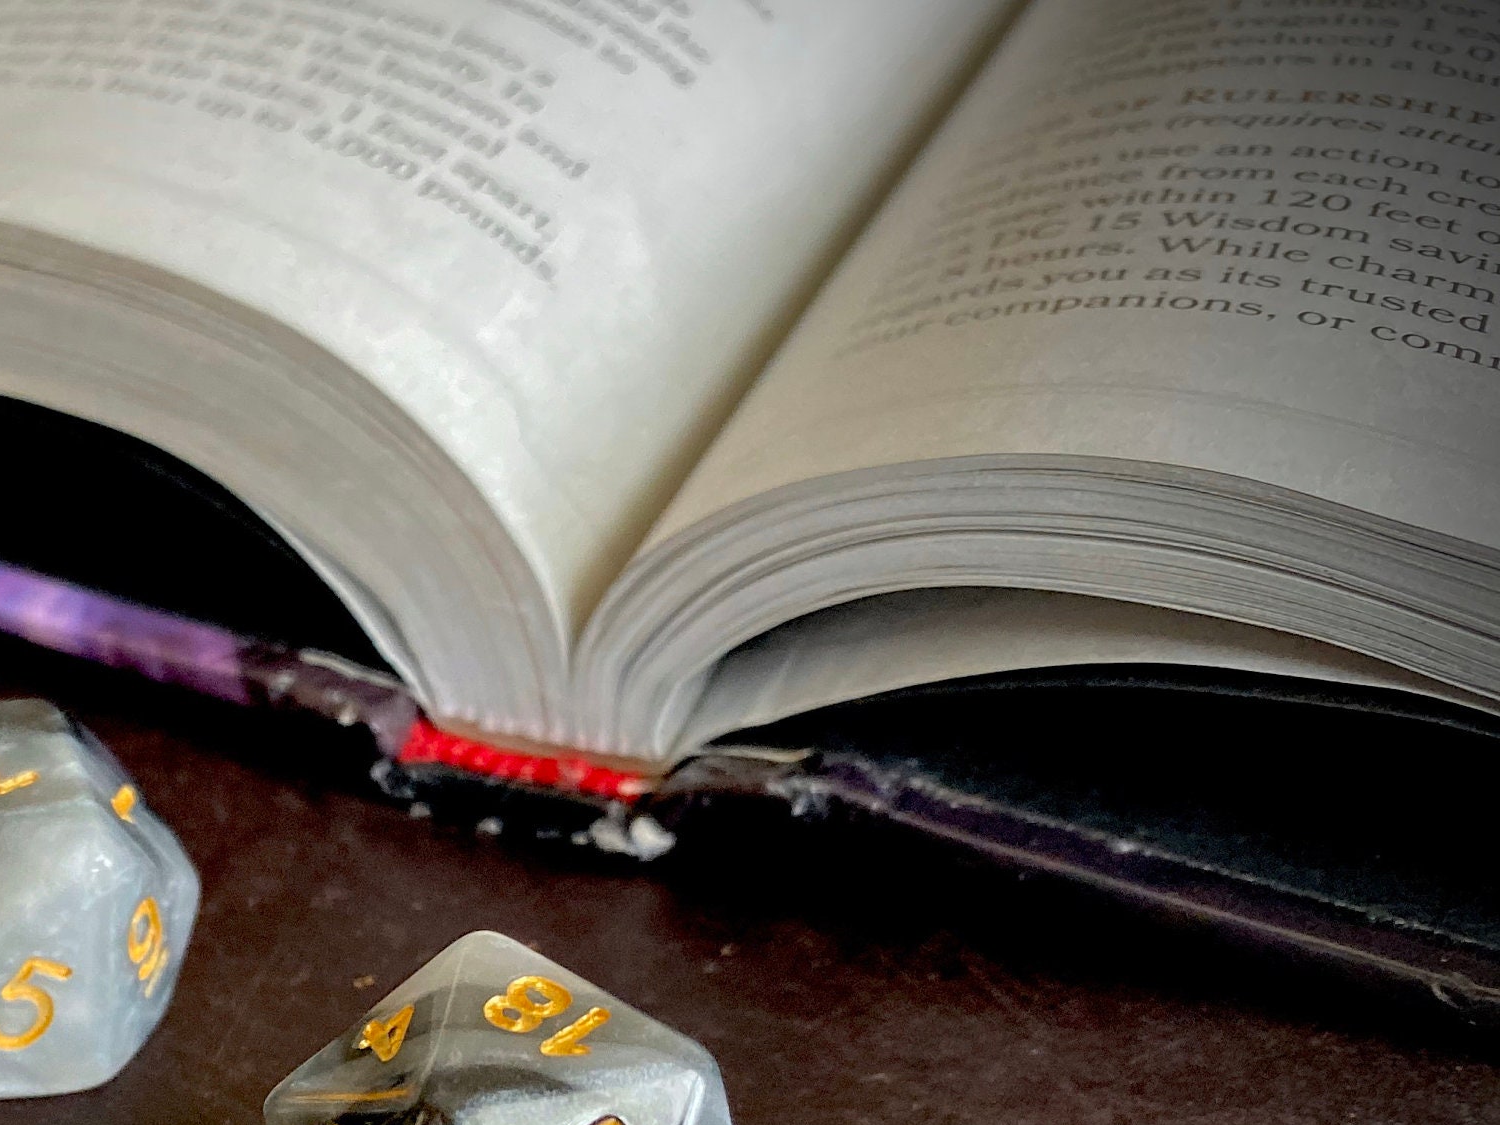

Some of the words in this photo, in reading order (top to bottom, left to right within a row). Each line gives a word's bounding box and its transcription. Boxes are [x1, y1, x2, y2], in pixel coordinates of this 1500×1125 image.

[1181, 87, 1495, 125] RULERSHIP
[1399, 124, 1500, 156] attu
[1159, 162, 1275, 182] from
[1293, 169, 1409, 196] each
[1215, 143, 1274, 157] an
[1291, 144, 1440, 175] action
[1460, 168, 1500, 189] to
[1083, 187, 1236, 208] within
[1256, 187, 1352, 212] 120
[1368, 202, 1462, 235] feet
[1088, 212, 1143, 233] 15
[1162, 210, 1370, 245] Wisdom
[1158, 235, 1311, 264] While
[945, 291, 1277, 326] companions,
[1297, 310, 1357, 331] or
[1032, 268, 1128, 291] you
[1144, 267, 1203, 282] as
[1219, 266, 1283, 289] its
[1300, 277, 1490, 334] trusted
[358, 1005, 415, 1062] 4
[483, 975, 611, 1057] 18
